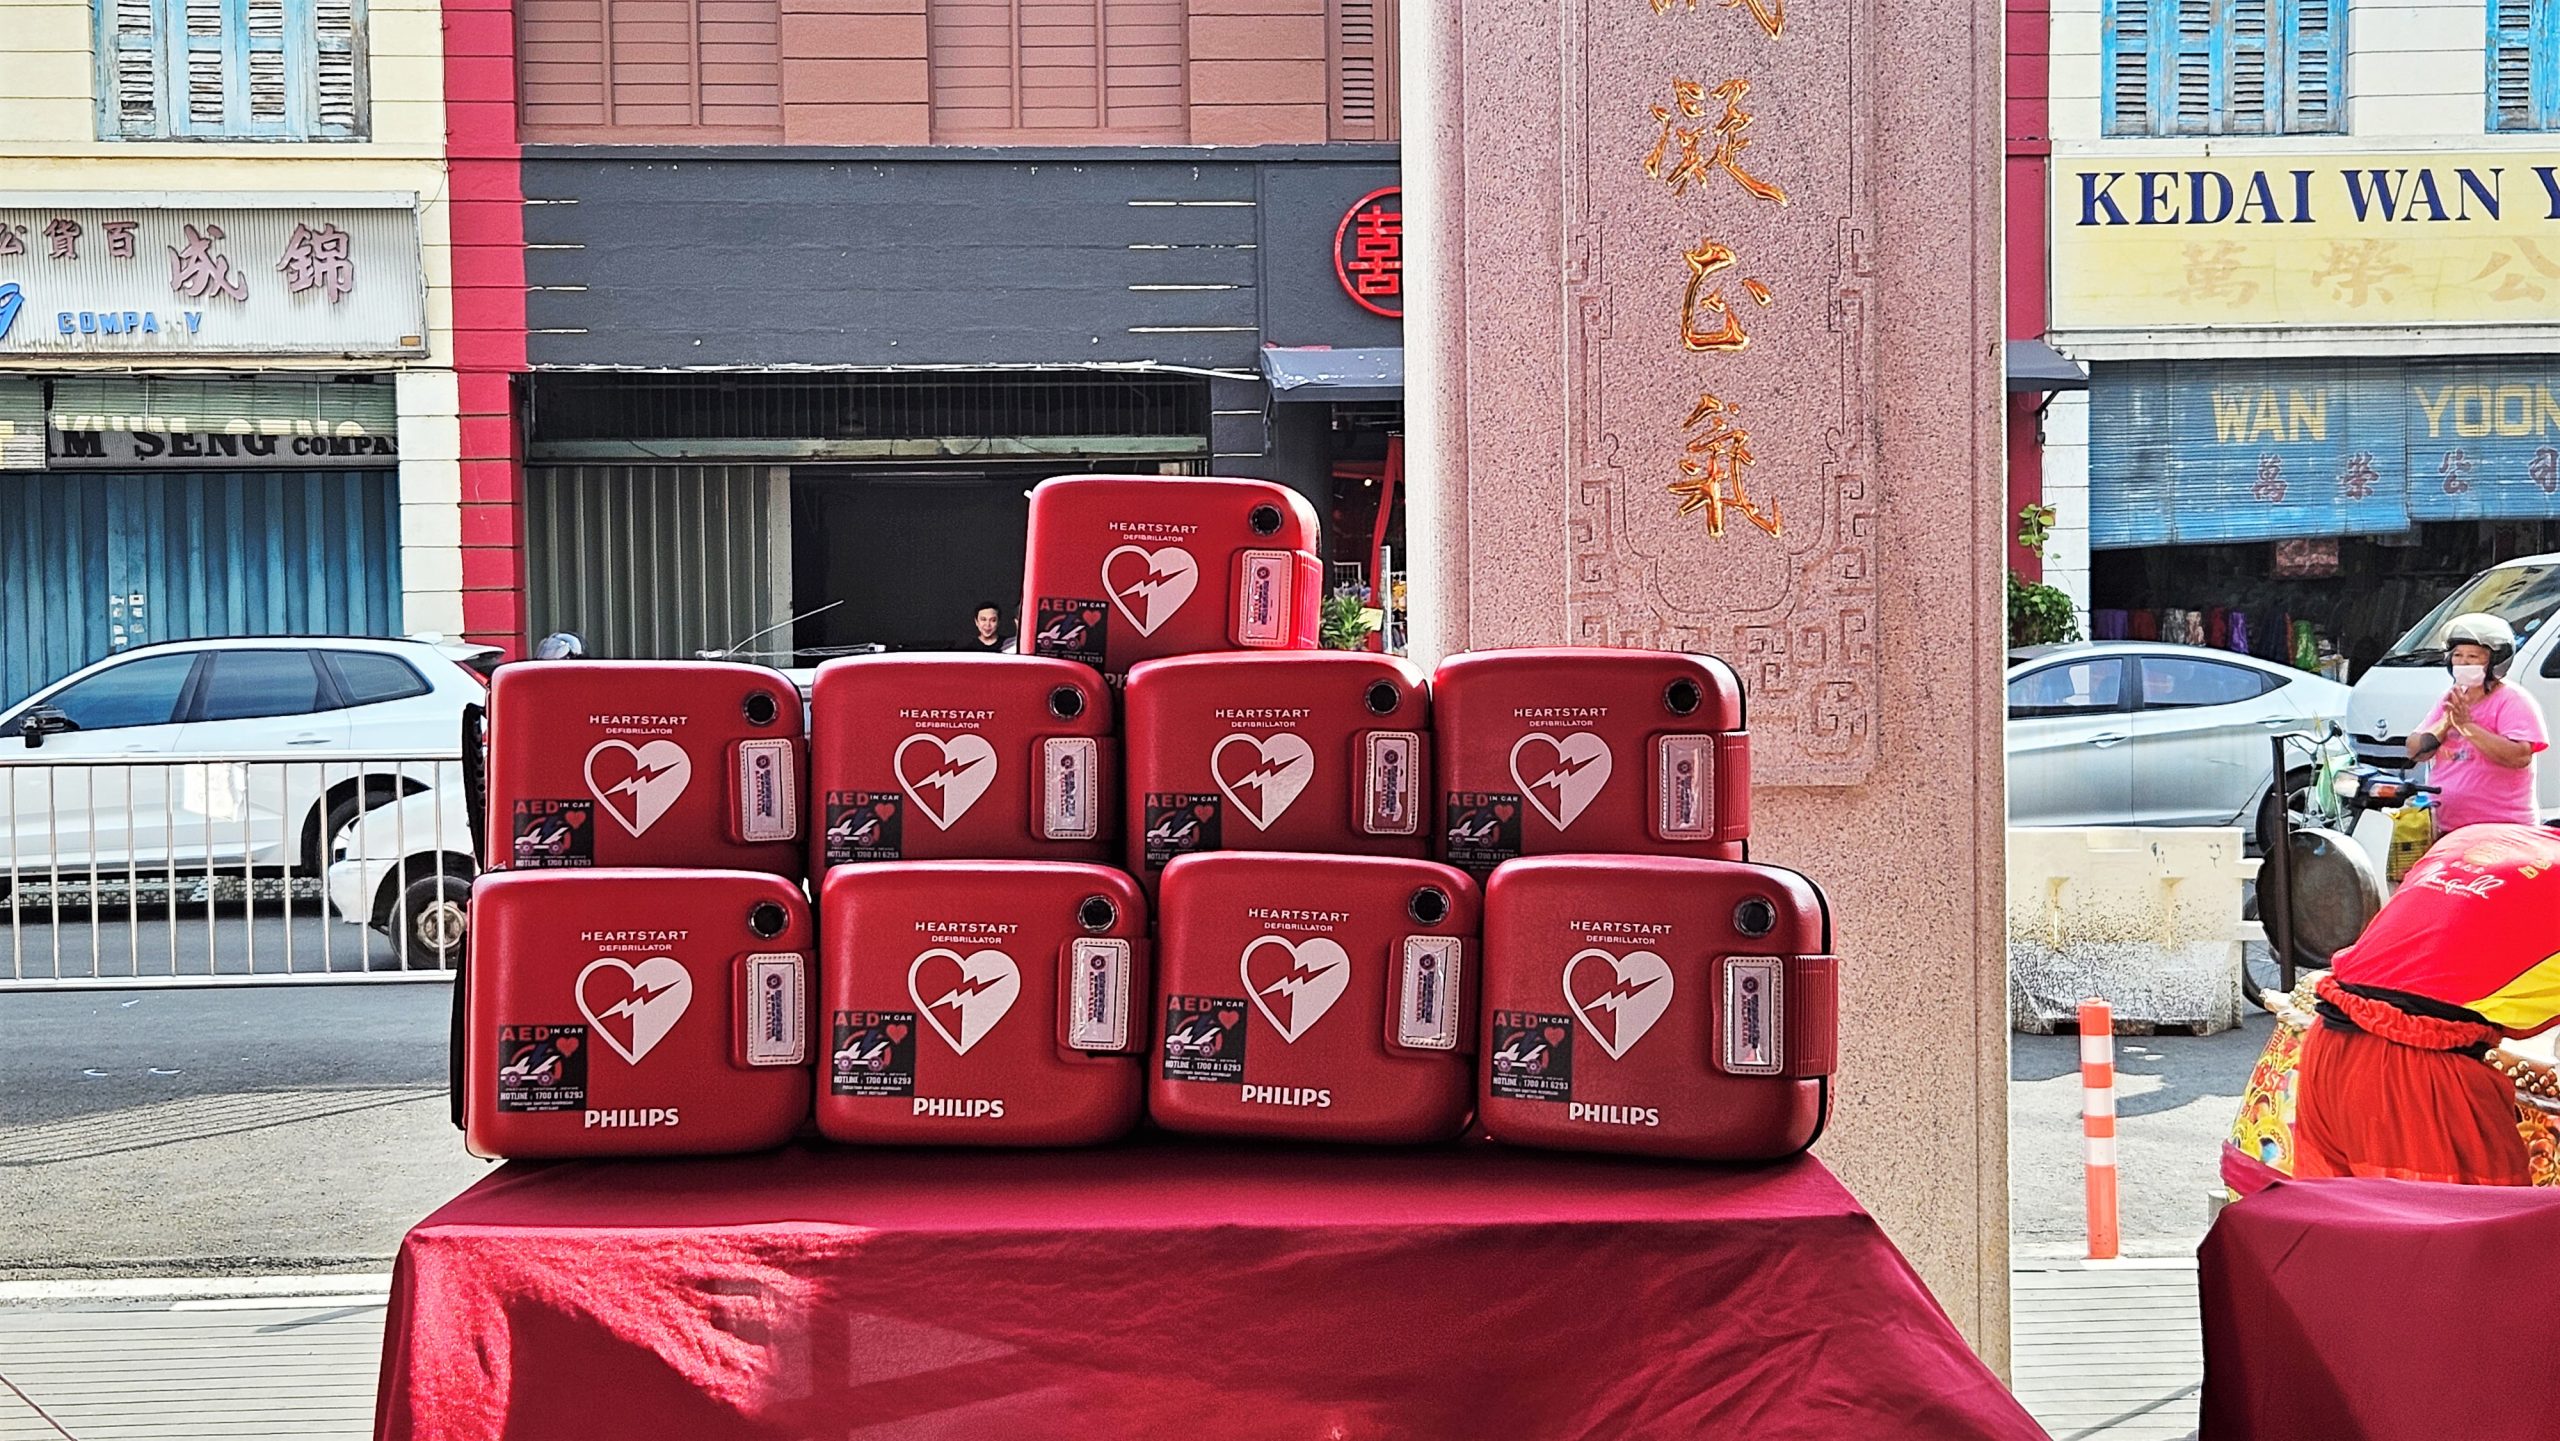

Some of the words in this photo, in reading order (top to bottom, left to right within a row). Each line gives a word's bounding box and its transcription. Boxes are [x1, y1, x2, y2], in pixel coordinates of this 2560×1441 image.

[2076, 170, 2316, 226] KEDAI
[2339, 167, 2505, 222] WAN
[2211, 388, 2327, 444] WAN
[133, 431, 280, 457] SENG
[1110, 522, 1197, 535] HEARTSTART
[1123, 534, 1183, 542] DEFIBRILLATOR
[1040, 599, 1078, 612] AED
[900, 710, 994, 719] HEARTSTART
[1515, 708, 1607, 717] HEARTSTART
[590, 716, 687, 724] HEARTSTART
[827, 792, 870, 806] AED
[1146, 794, 1188, 808] AED
[1448, 793, 1490, 806] AED
[515, 801, 560, 815] AED
[1249, 909, 1349, 924] HEARTSTART
[916, 922, 1017, 933] HEARTSTART
[1265, 923, 1332, 931] DEFIBRILLATOR
[1571, 921, 1671, 936] HEARTSTART
[582, 931, 688, 940] HEARTSTART
[1587, 935, 1655, 944] DEFIBRILLATOR
[1168, 996, 1213, 1011] AED
[835, 1012, 880, 1026] AED
[1495, 1012, 1538, 1027] AED
[500, 1027, 550, 1041] AED
[1165, 1059, 1190, 1070] HOTLINE
[1196, 1061, 1212, 1071] 1700
[1213, 1062, 1222, 1071] 81
[1223, 1062, 1241, 1072] 6293
[834, 1075, 859, 1084] HOTLINE
[865, 1076, 882, 1085] 1700
[883, 1076, 892, 1085] 81
[893, 1076, 912, 1086] 6293
[1493, 1076, 1518, 1087] HOTLINE
[1523, 1078, 1539, 1088] 1700
[1540, 1079, 1549, 1089] 81
[1550, 1080, 1569, 1090] 6293
[500, 1091, 528, 1101] HOTLINE
[535, 1091, 552, 1100] 1700
[554, 1091, 563, 1100] 81
[564, 1090, 584, 1100] 6293
[1242, 1085, 1330, 1107] PHILIPS
[913, 1098, 1003, 1117] PHILIPS
[1570, 1103, 1658, 1126] PHILIPS
[585, 1109, 678, 1127] PHILIPS
